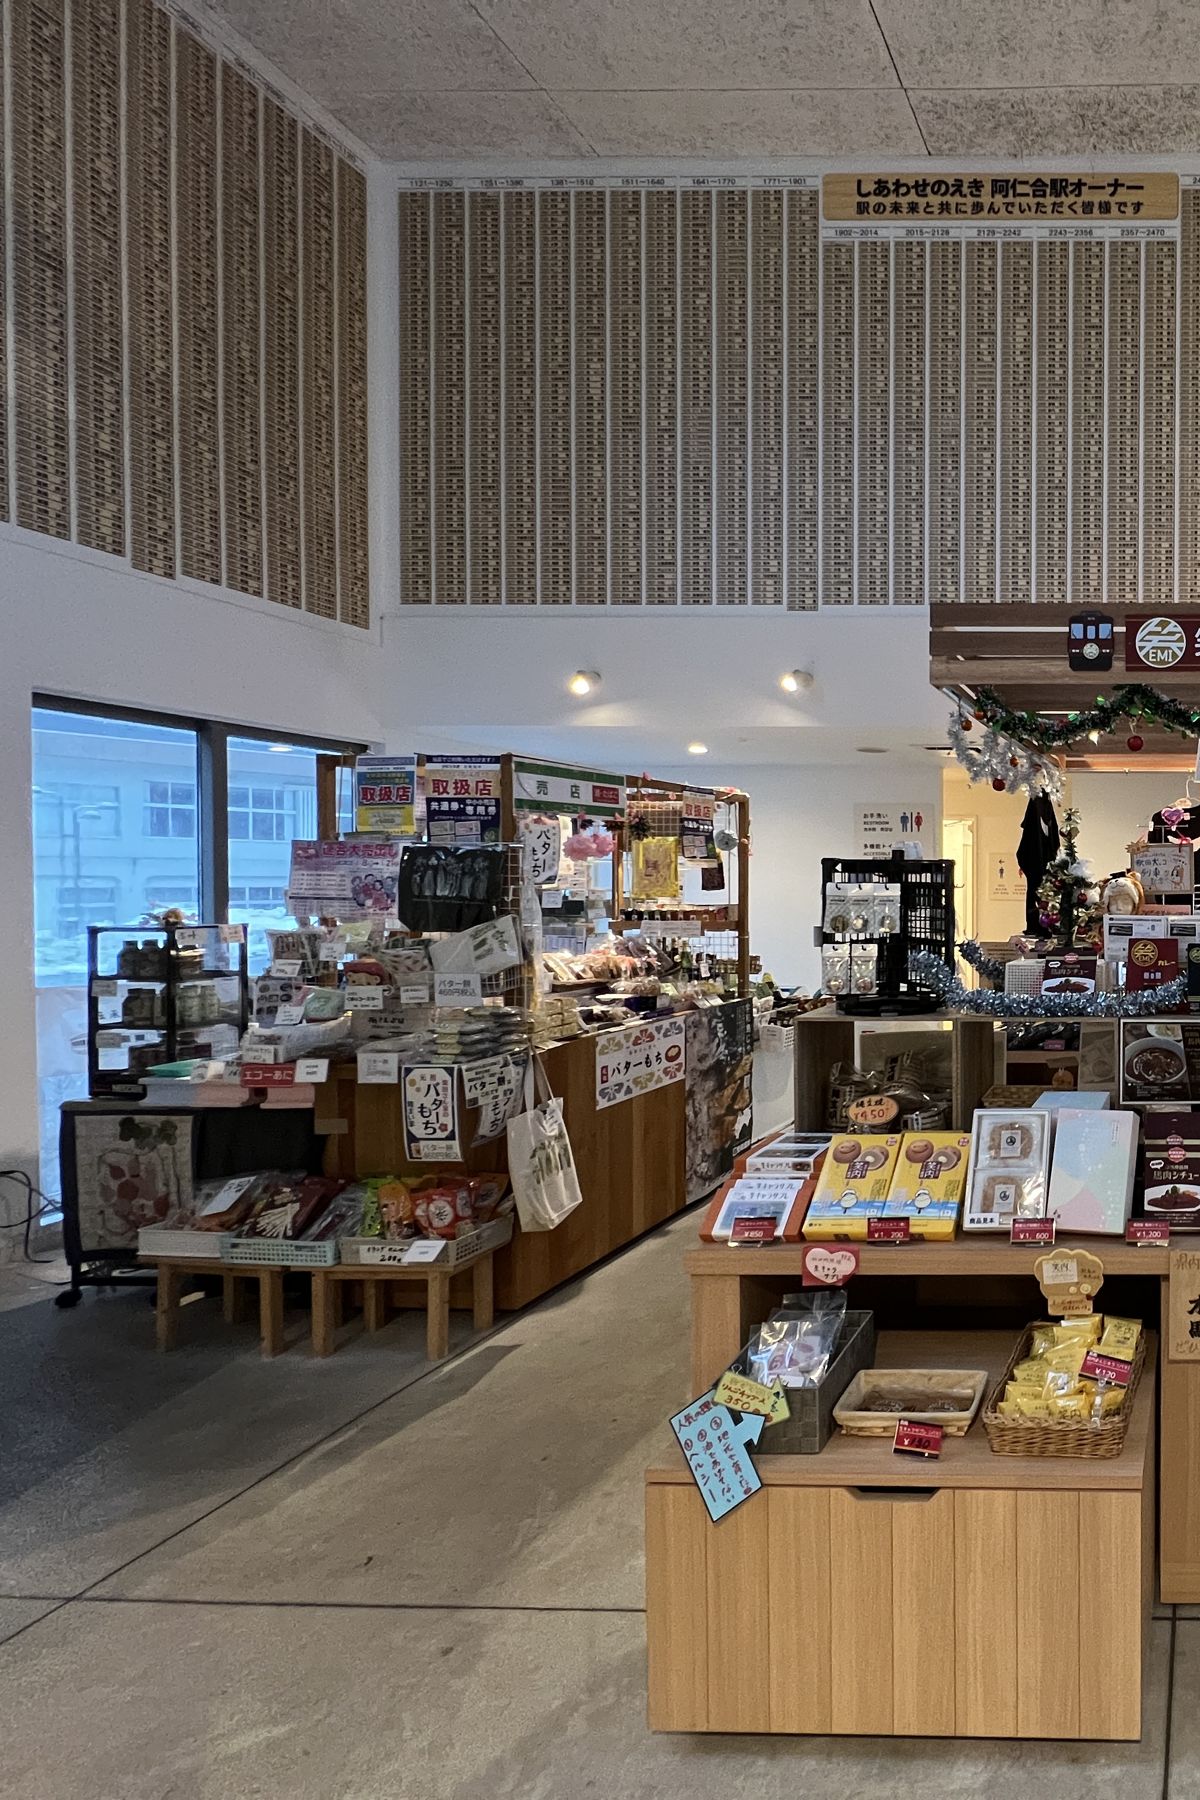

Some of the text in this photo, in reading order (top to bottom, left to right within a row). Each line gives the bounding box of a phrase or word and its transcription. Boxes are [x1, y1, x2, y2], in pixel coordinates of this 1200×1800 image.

[856, 178, 1145, 198] しあわせのえき 阿仁合駅オーナー
[856, 201, 1145, 215] 駅の未来と共に歩んでいただく皆様です
[1149, 650, 1174, 662] EMI
[361, 786, 412, 802] 取扱店
[432, 779, 492, 796] 取扱店
[536, 780, 580, 799] 売店
[611, 1051, 662, 1077] バターもち
[244, 1068, 293, 1081] エコーあに
[424, 1082, 442, 1124] バター
[418, 1103, 437, 1135] もち
[724, 1395, 751, 1410] 350
